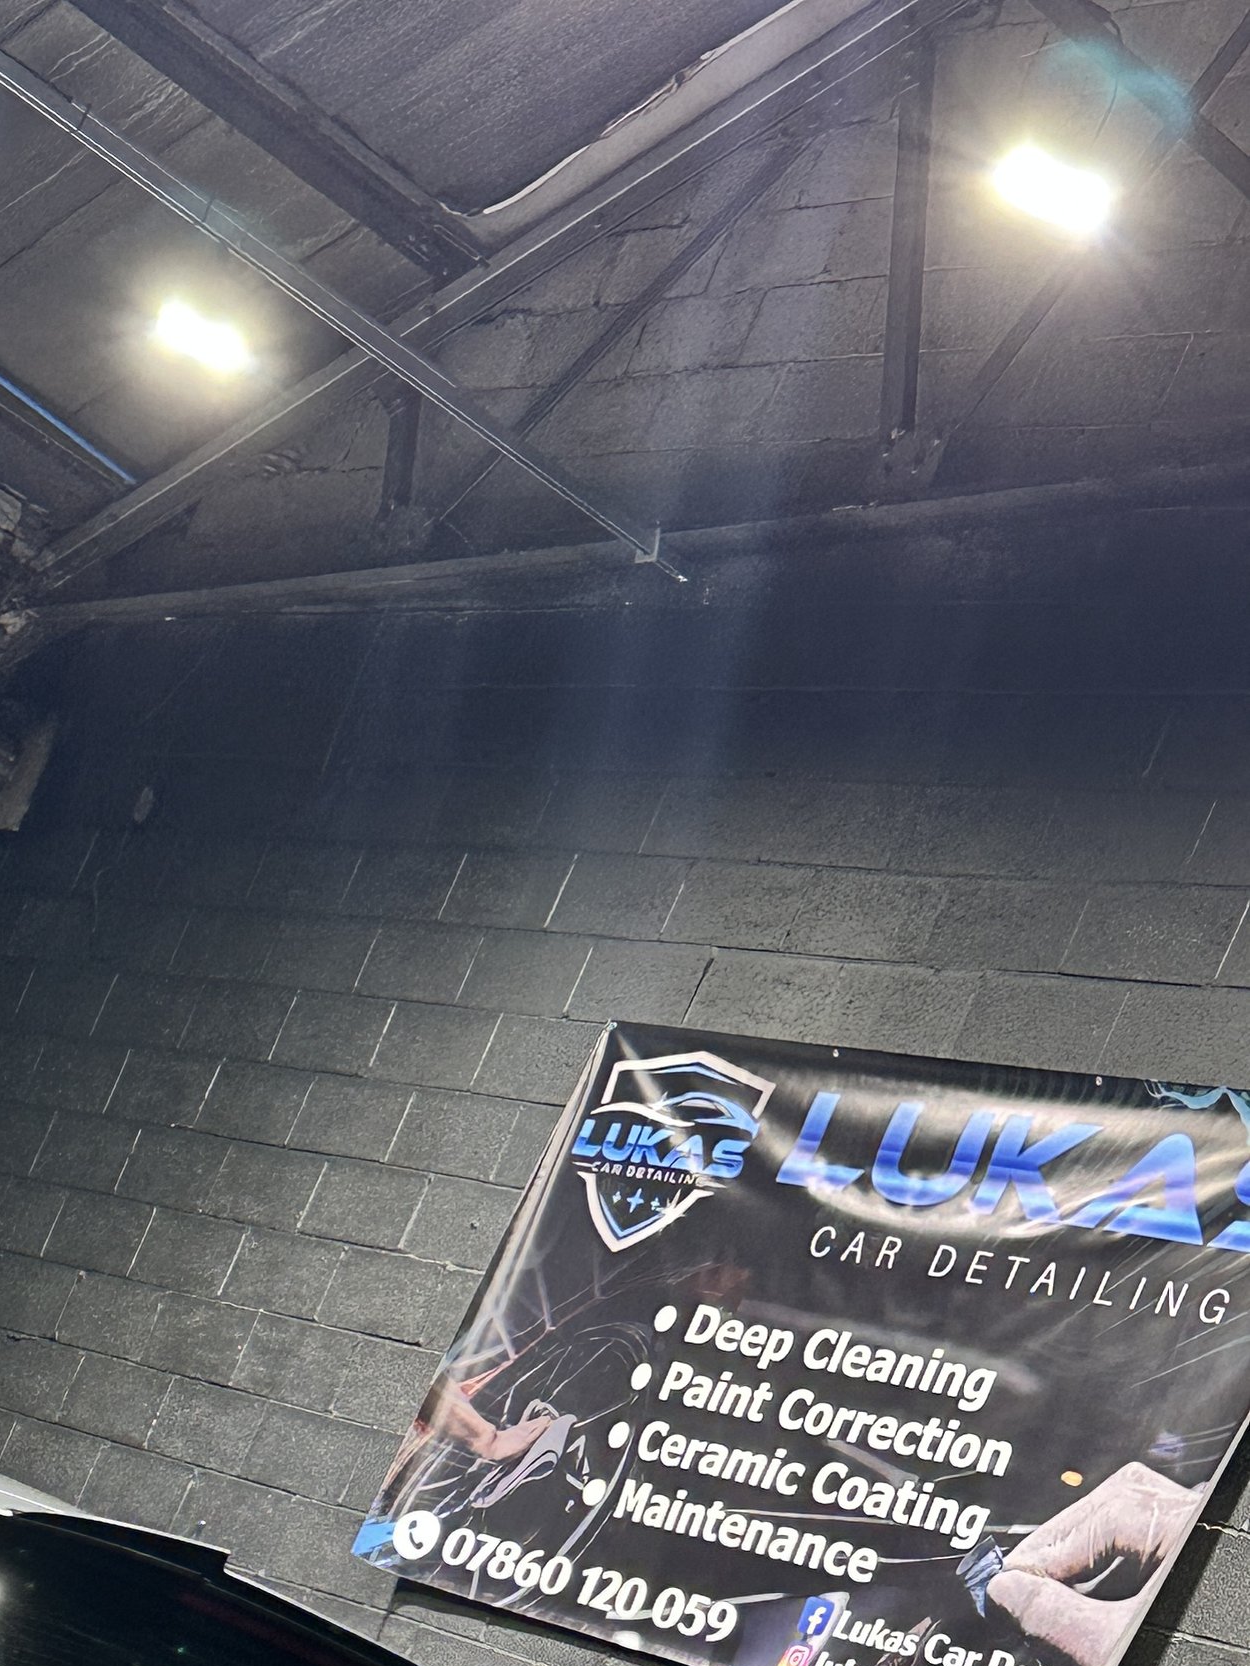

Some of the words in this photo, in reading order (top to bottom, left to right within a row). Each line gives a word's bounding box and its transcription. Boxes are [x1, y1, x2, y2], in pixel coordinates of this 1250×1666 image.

[571, 1119, 751, 1179] LUKAS
[591, 1161, 623, 1177] CAR
[810, 1225, 902, 1269] CAR
[928, 1244, 1230, 1325] DETAILING
[684, 1304, 795, 1370] Deep
[803, 1328, 998, 1412] Cleaning
[658, 1361, 774, 1422] Paint
[778, 1388, 1013, 1476] Correction
[613, 1478, 878, 1583] Maintenance
[637, 1420, 806, 1496] Ceramic
[811, 1462, 991, 1550] Coating
[441, 1527, 573, 1595] 07860
[576, 1566, 648, 1619] 120
[652, 1587, 738, 1642] 059
[832, 1611, 920, 1657] Lukas
